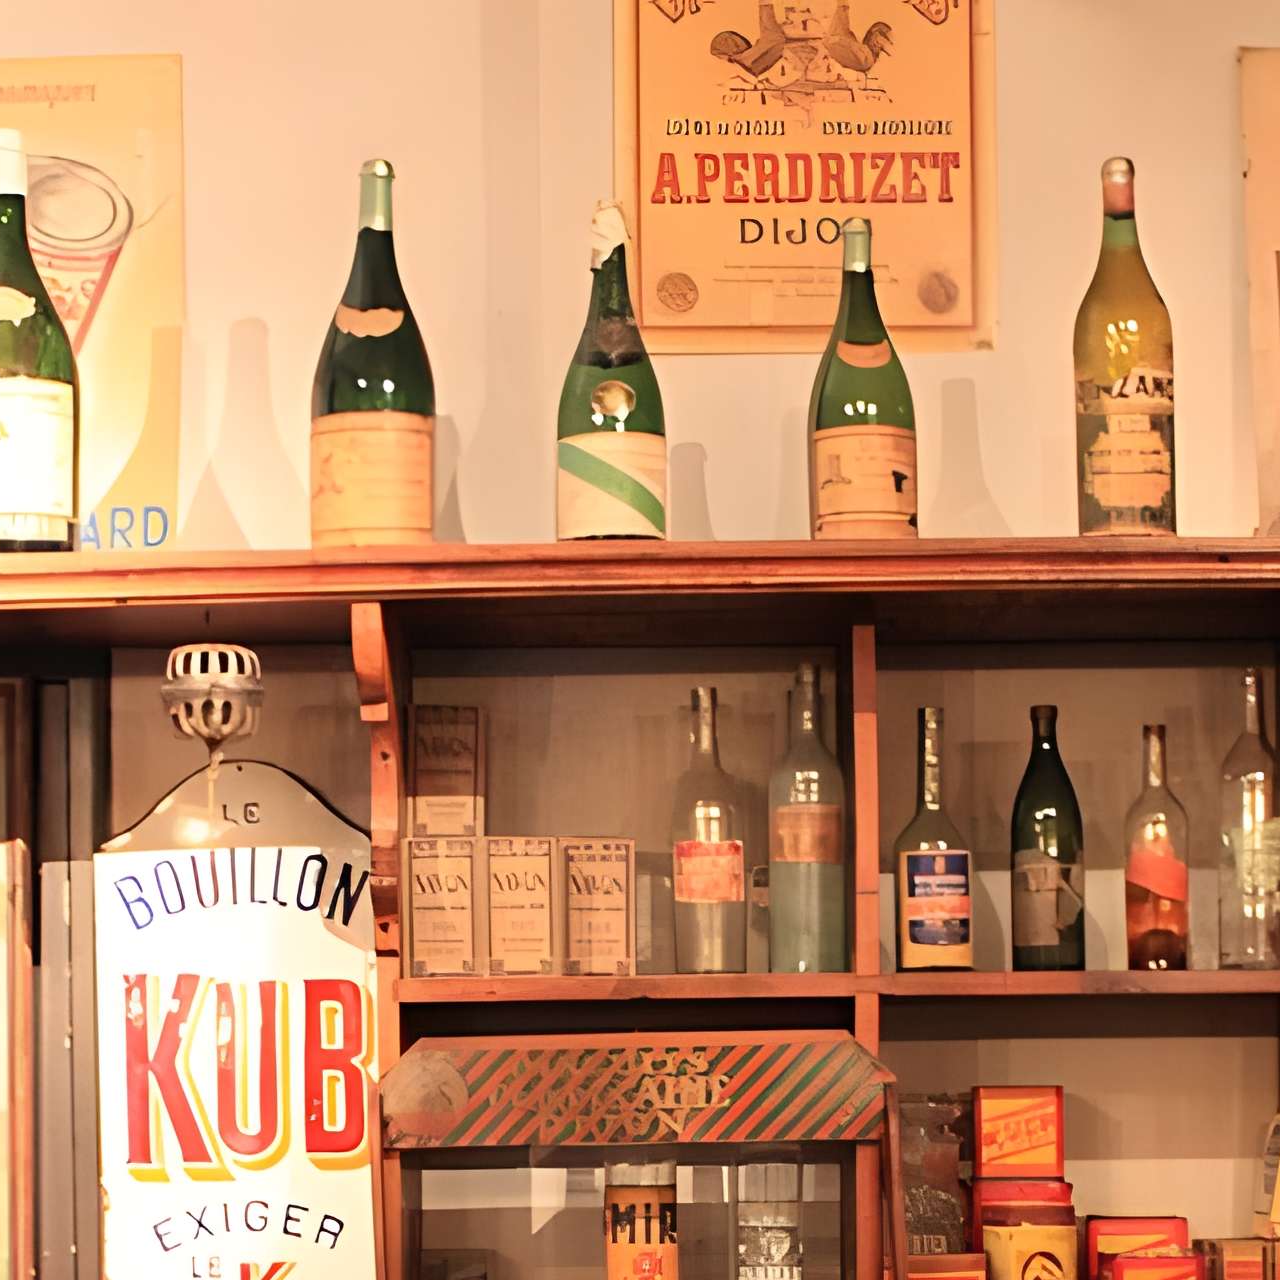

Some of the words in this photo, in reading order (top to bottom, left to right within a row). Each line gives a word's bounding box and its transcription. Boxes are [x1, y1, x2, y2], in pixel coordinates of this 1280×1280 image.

[739, 217, 843, 246] DIJO
[114, 847, 370, 930] BOUILLON
[123, 973, 377, 1180] KUB
[152, 1199, 345, 1253] EXIGER
